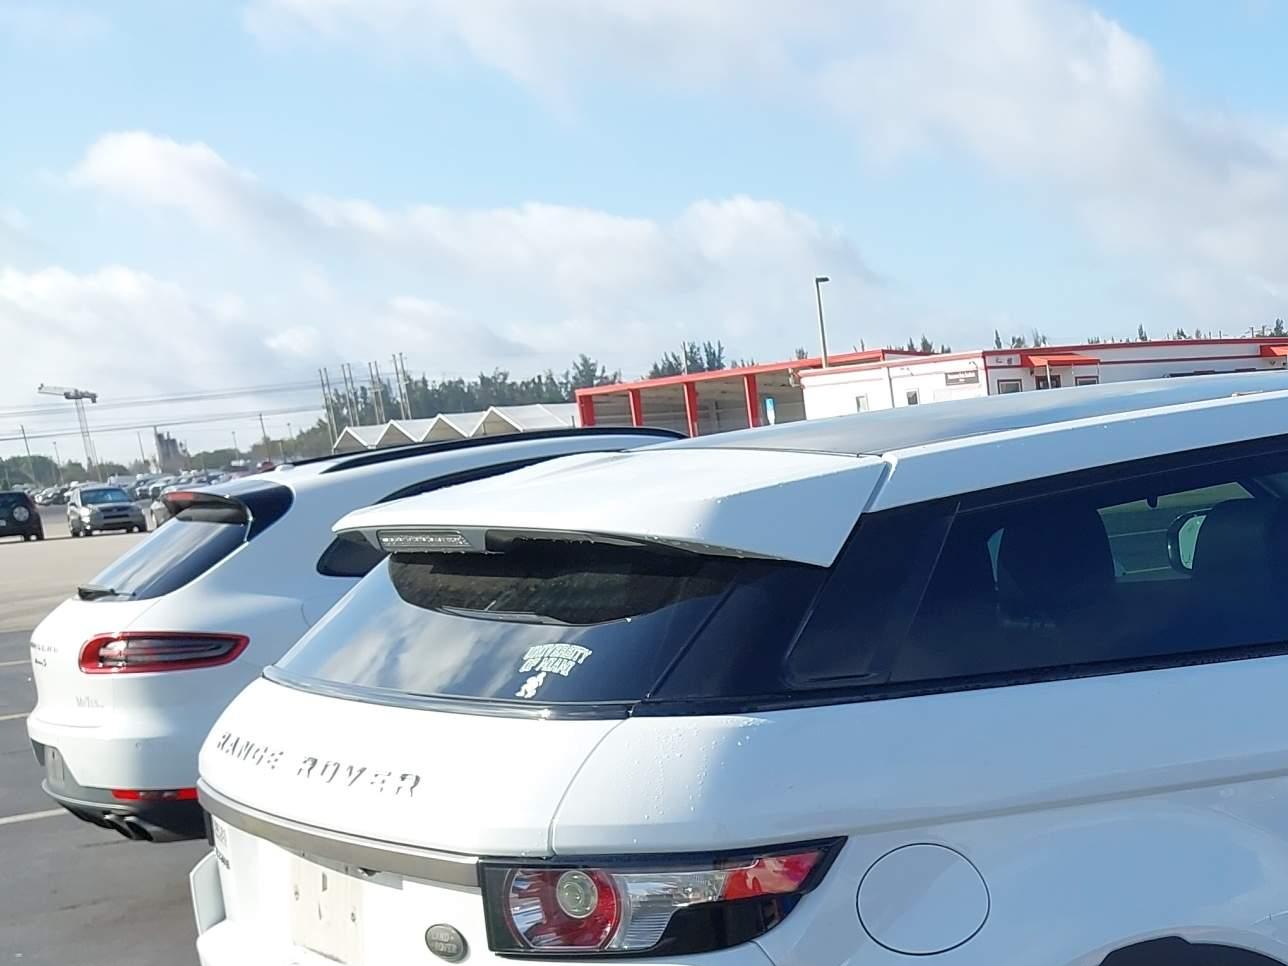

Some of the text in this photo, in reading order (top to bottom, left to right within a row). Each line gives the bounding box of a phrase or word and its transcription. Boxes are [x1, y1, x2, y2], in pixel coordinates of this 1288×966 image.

[523, 644, 592, 664] UNIVERSITY
[217, 732, 421, 798] RANGE ROVER
